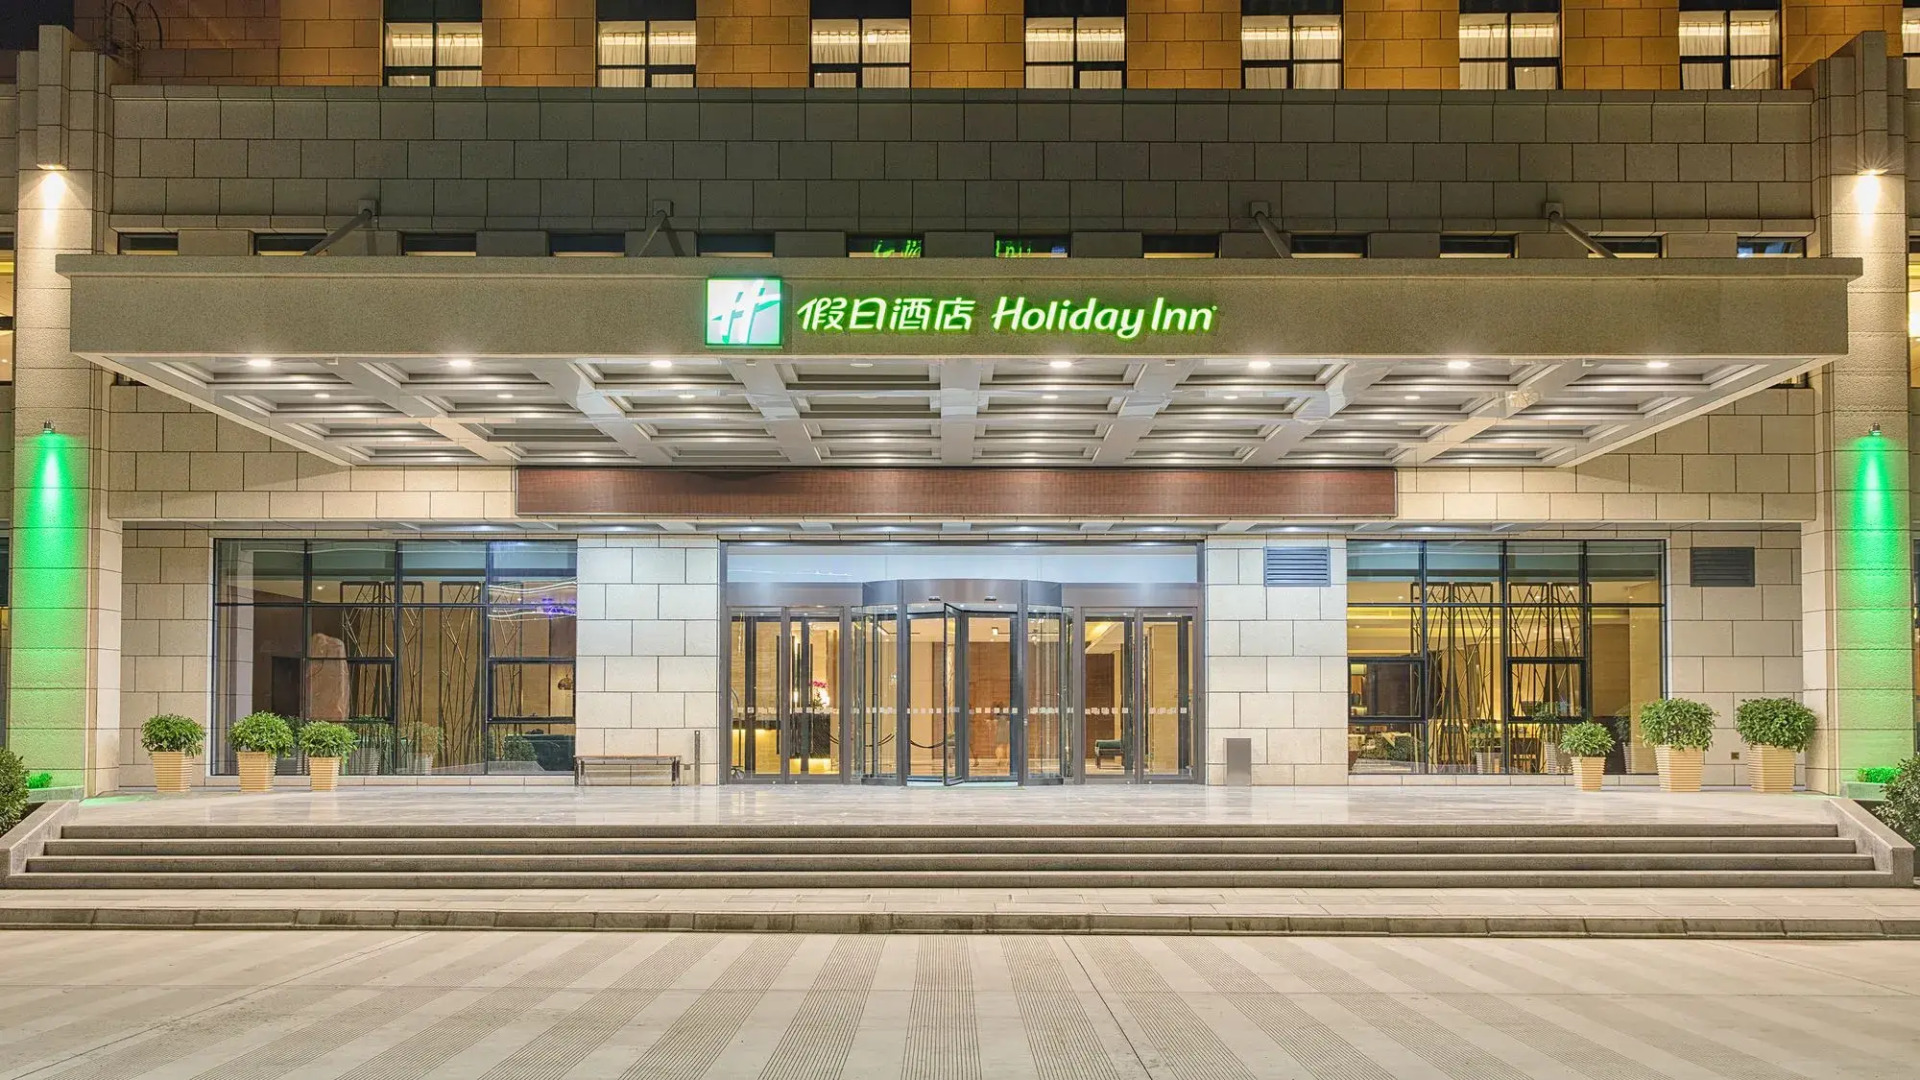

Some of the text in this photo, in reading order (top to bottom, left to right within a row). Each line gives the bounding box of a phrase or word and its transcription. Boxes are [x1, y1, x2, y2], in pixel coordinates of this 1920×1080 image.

[797, 296, 976, 331] 假日酒店
[991, 295, 1216, 339] Holiday Inn
